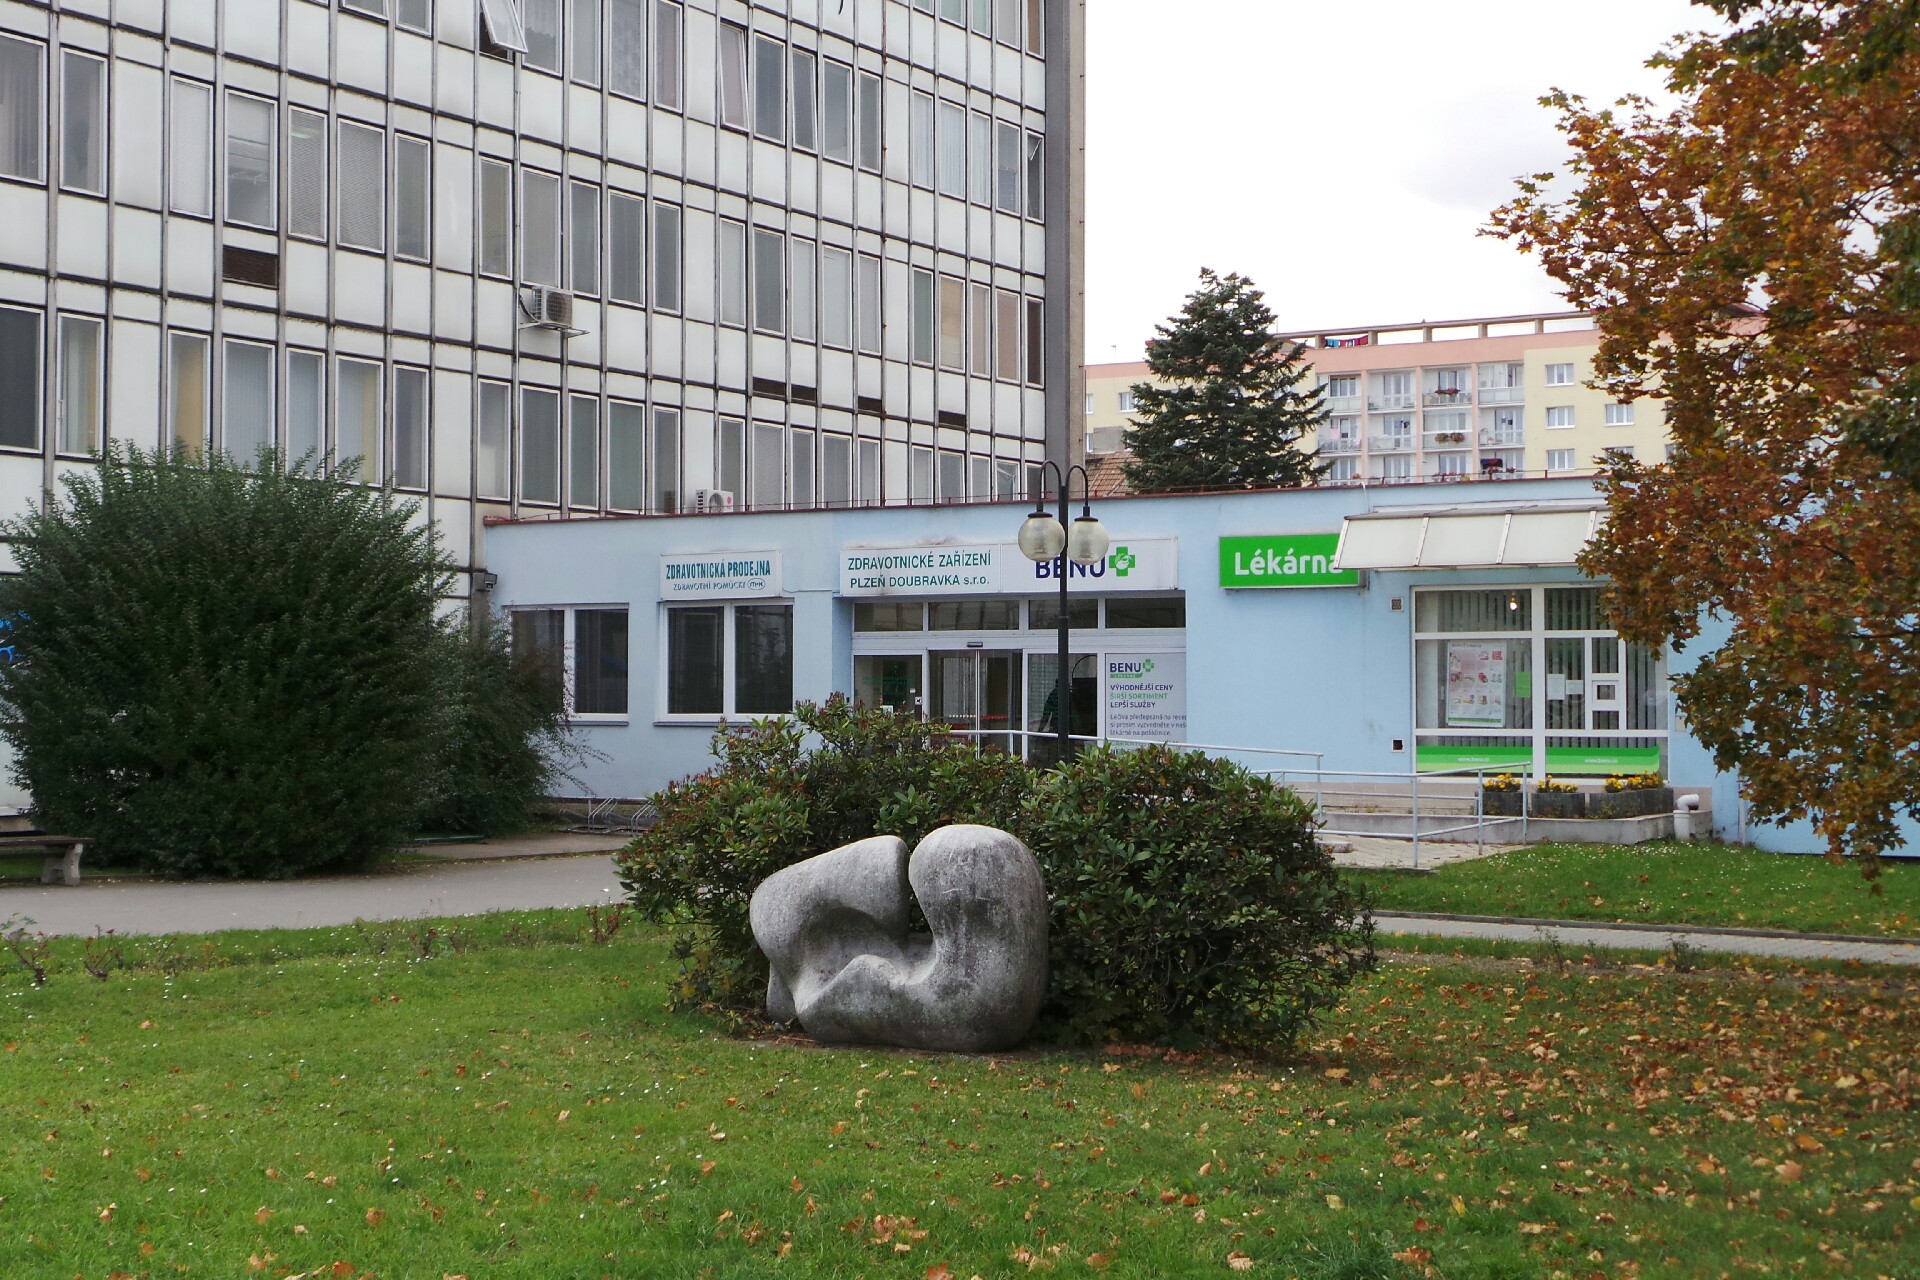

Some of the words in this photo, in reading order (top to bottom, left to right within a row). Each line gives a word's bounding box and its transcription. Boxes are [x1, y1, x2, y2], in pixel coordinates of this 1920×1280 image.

[848, 551, 934, 570] ZDRAVOTNICKÉ
[939, 549, 991, 567] ZAŘÍZENÍ
[666, 559, 725, 579] ZDRAVOTNICKÁ
[727, 560, 771, 577] PRODEJNA
[850, 575, 885, 588] PLZEŇ
[889, 575, 960, 587] DOUBRAVKA
[963, 576, 990, 585] s.r.o.
[1109, 662, 1142, 673] BENU
[1110, 683, 1154, 691] VÝHODNĚJŠÍ
[1110, 700, 1128, 708] LEPŠÍ
[1129, 700, 1156, 708] SLUŽBY
